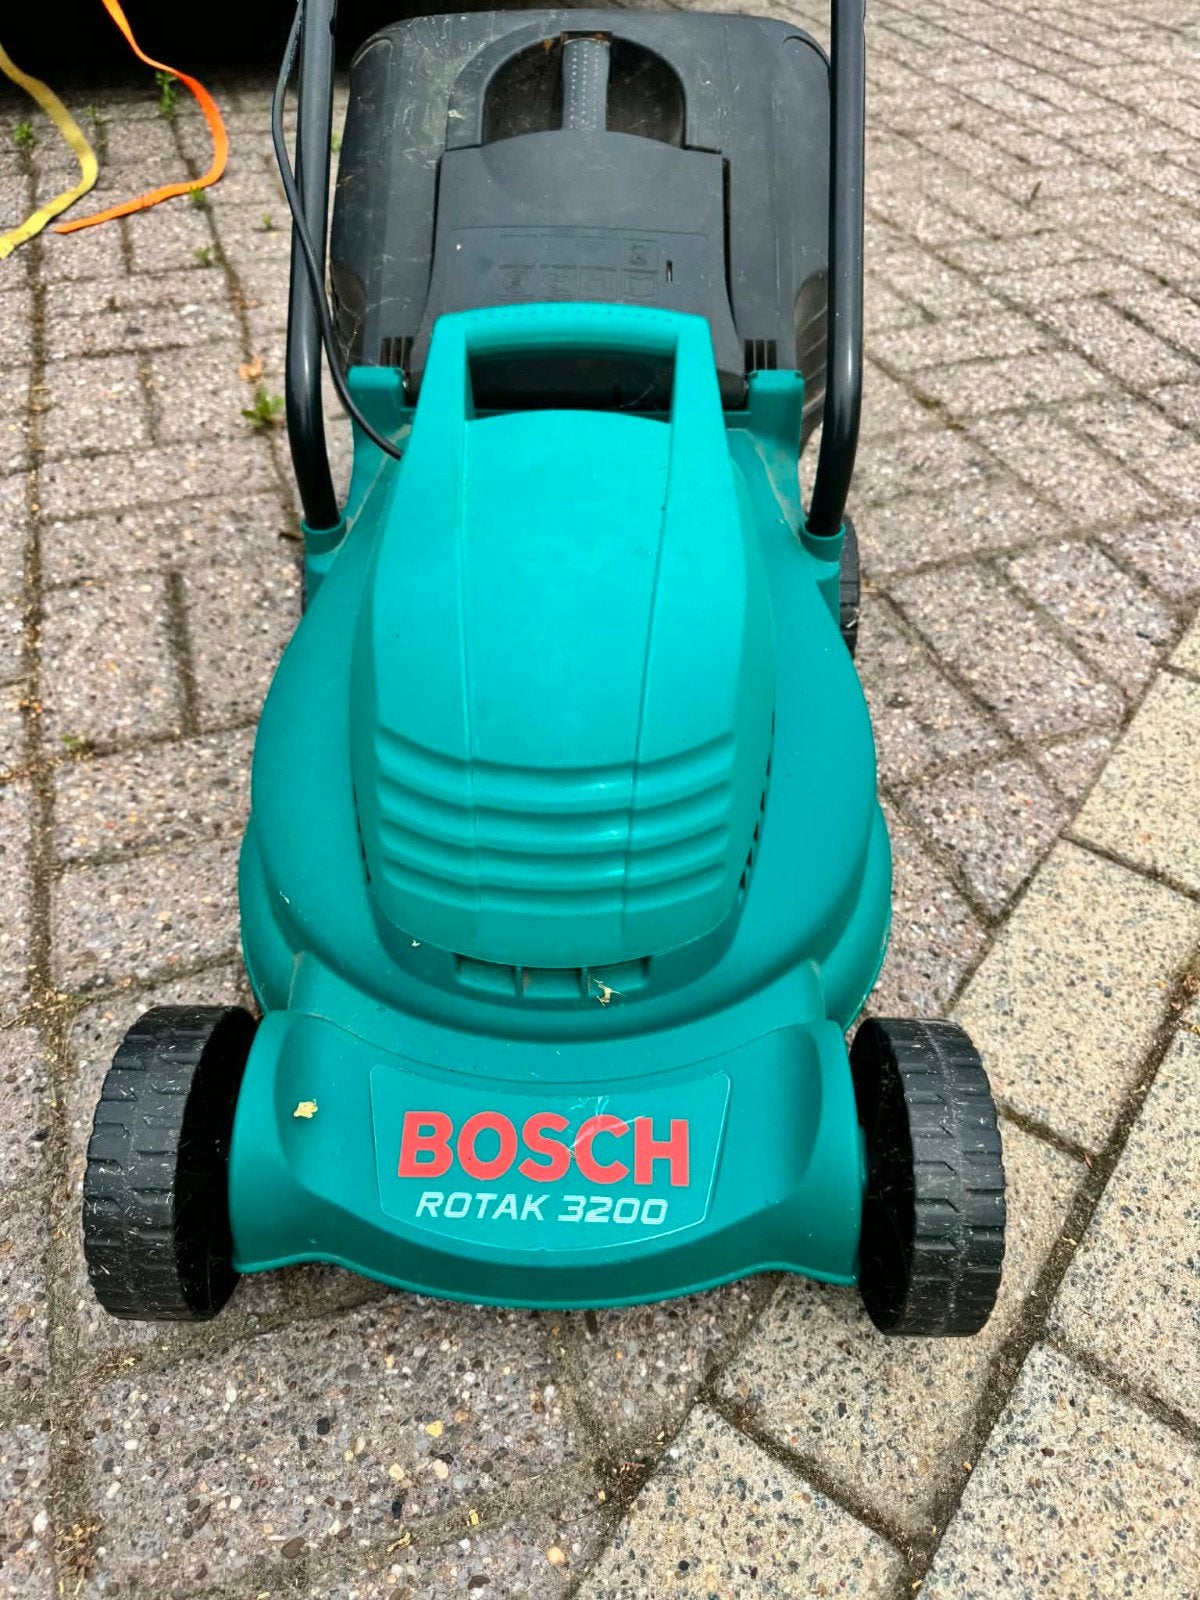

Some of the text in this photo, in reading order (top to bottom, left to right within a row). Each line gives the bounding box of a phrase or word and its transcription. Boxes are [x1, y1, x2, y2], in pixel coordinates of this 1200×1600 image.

[399, 1111, 689, 1186] BOSCH
[416, 1192, 668, 1225] ROTAK 3200
